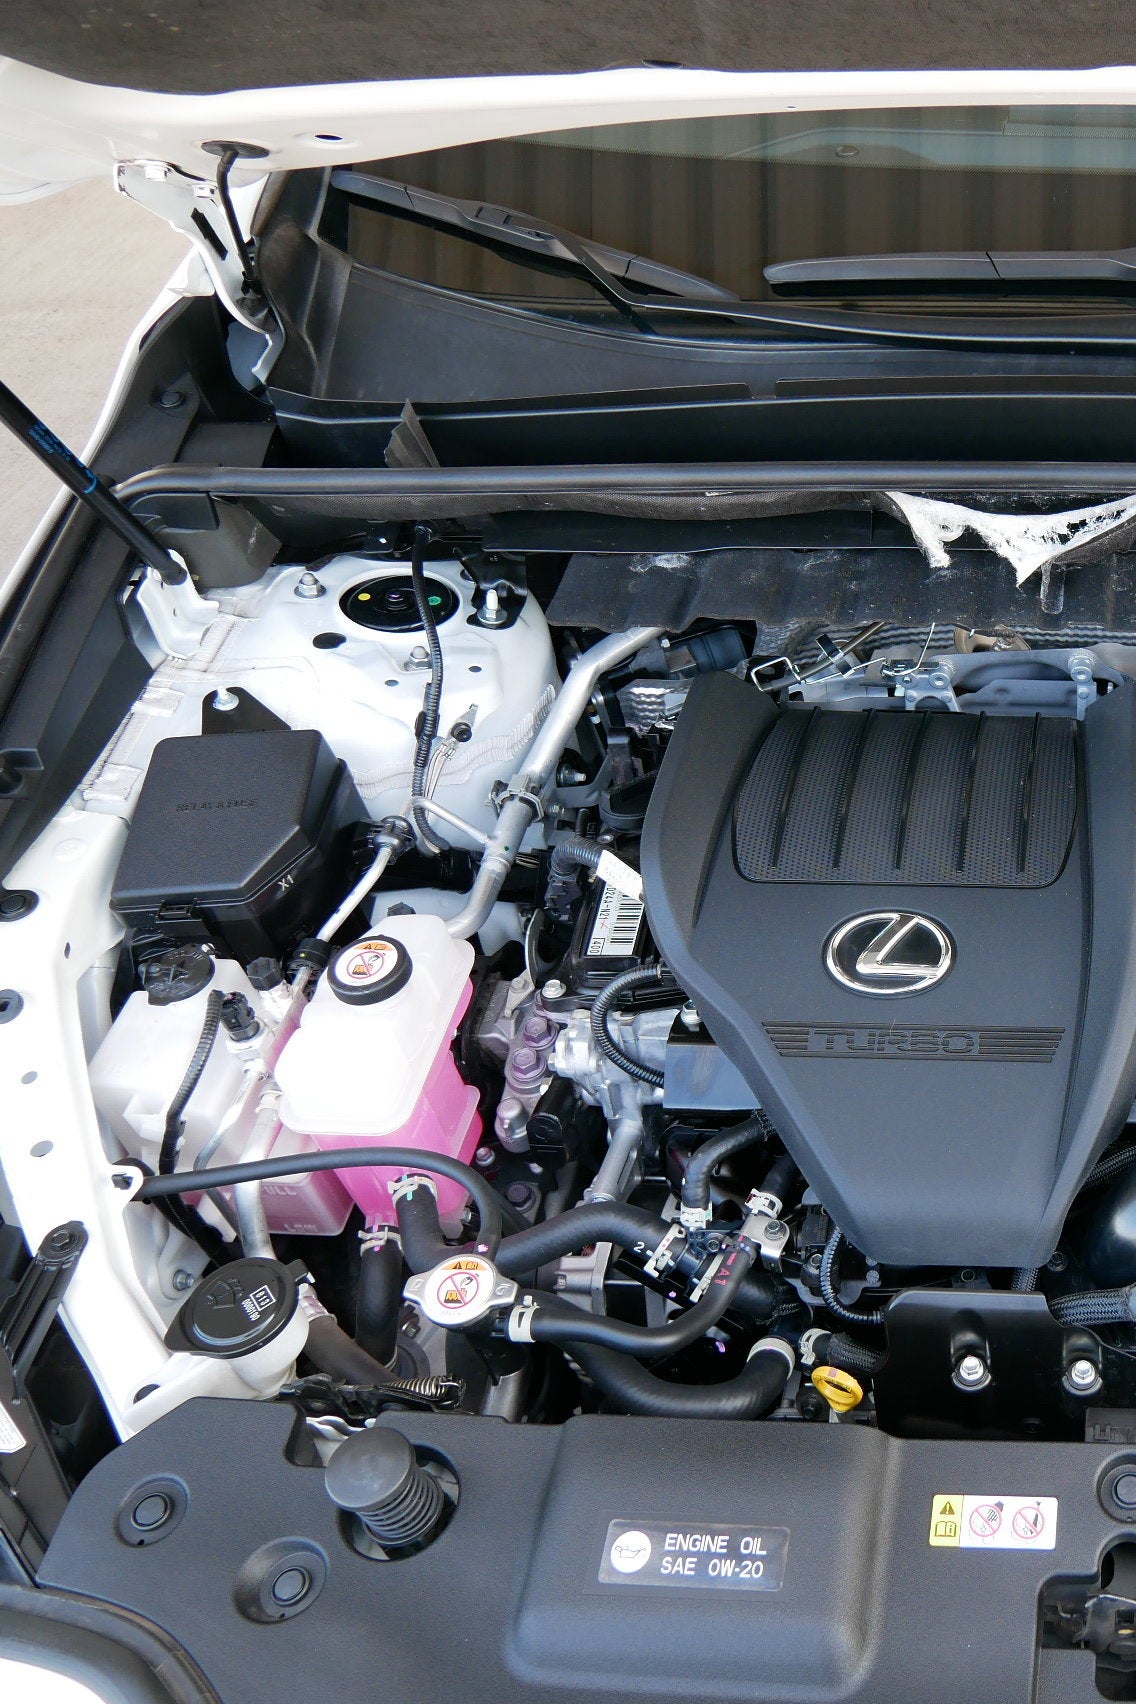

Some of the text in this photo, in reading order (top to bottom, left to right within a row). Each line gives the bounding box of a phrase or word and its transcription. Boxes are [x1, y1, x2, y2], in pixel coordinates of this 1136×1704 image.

[278, 875, 294, 892] X1
[813, 1028, 974, 1054] TURBO
[261, 1186, 297, 1196] ULL
[633, 1241, 645, 1252] 2
[664, 1533, 767, 1555] ENGINE OIL
[660, 1556, 764, 1578] SAE 0W-20
